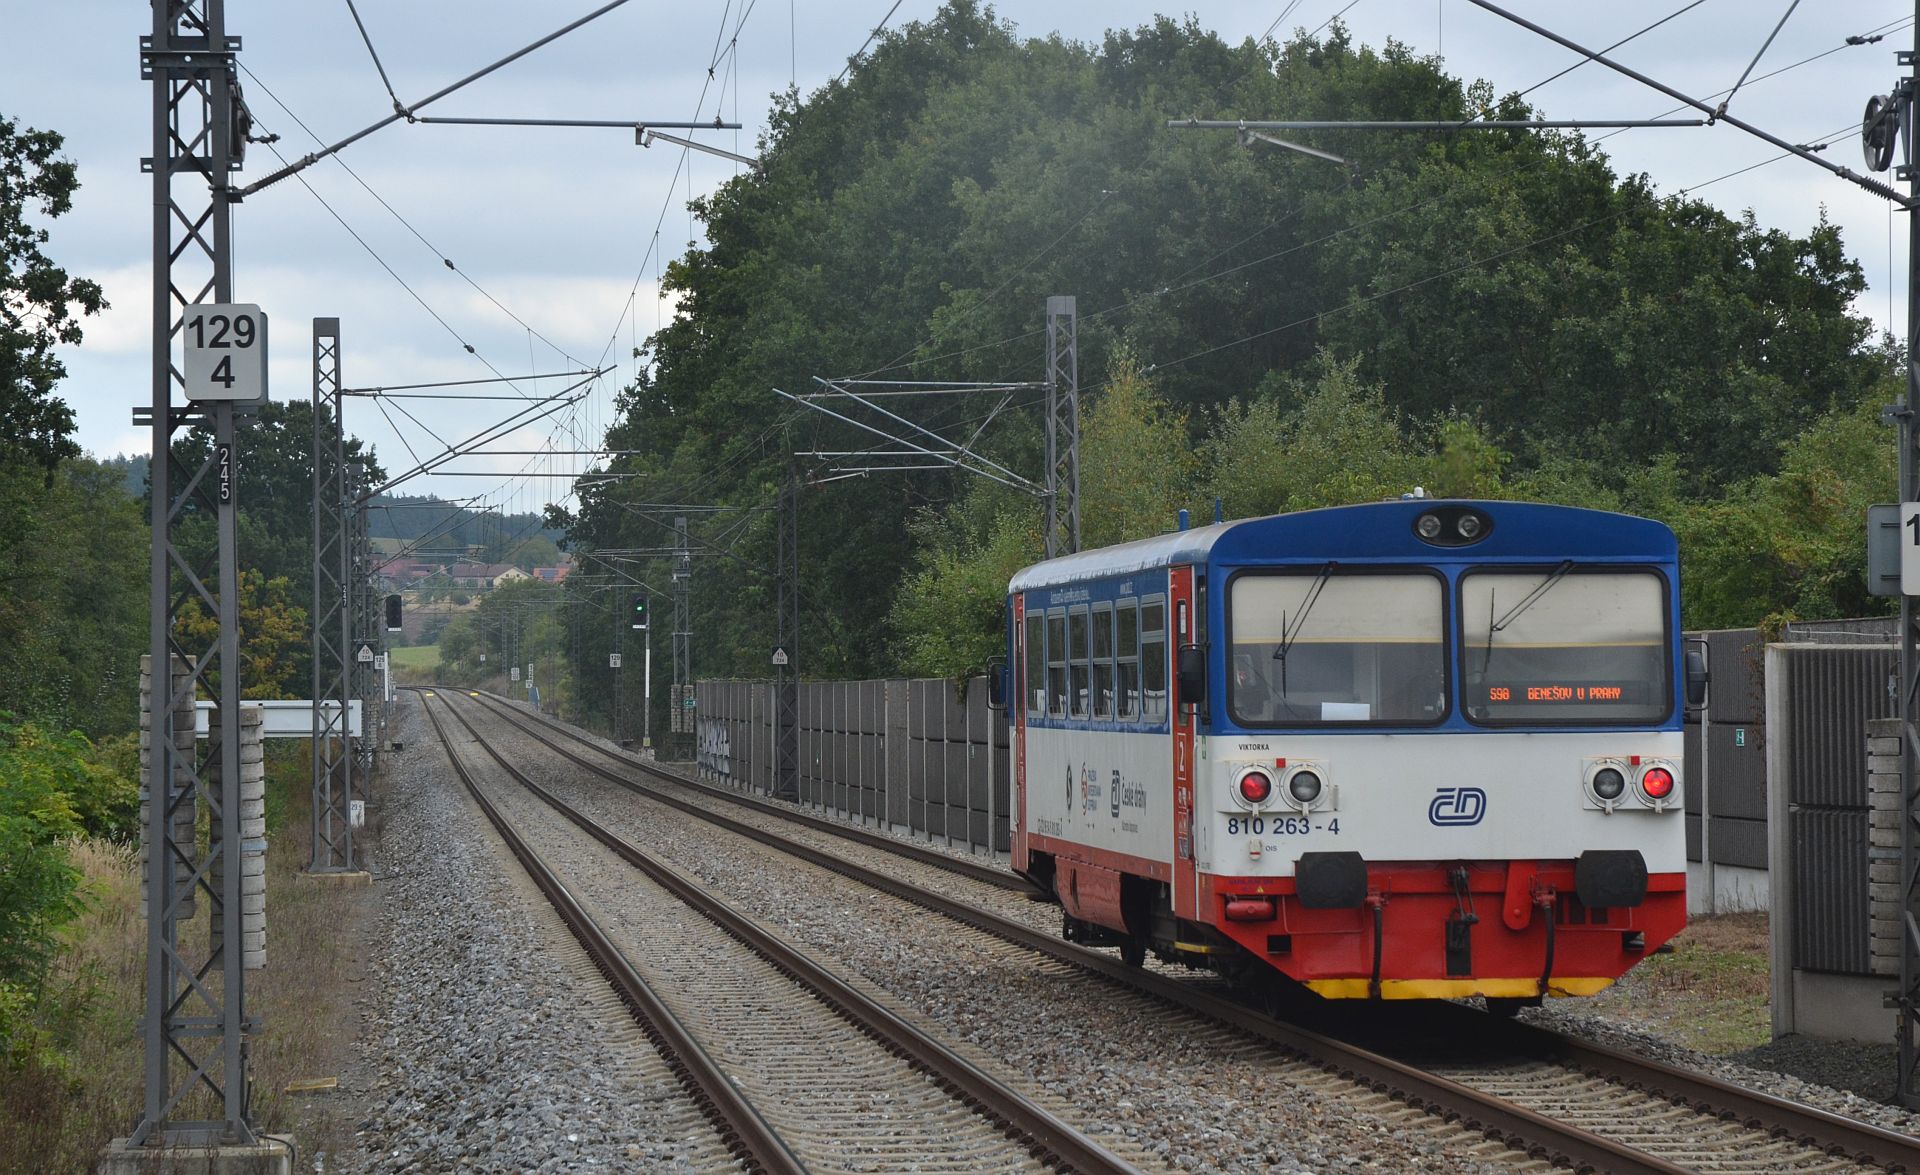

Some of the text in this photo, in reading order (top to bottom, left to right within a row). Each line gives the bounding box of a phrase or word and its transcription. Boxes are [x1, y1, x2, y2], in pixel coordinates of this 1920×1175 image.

[188, 314, 256, 349] 129
[210, 355, 236, 389] 4
[219, 447, 230, 500] 245
[1527, 685, 1573, 701] BENEŠOV
[1577, 687, 1585, 700] U
[1589, 687, 1622, 700] PRAHY
[1179, 741, 1185, 772] 2
[1238, 743, 1270, 751] VIKTORKA
[1228, 817, 1265, 835] 810
